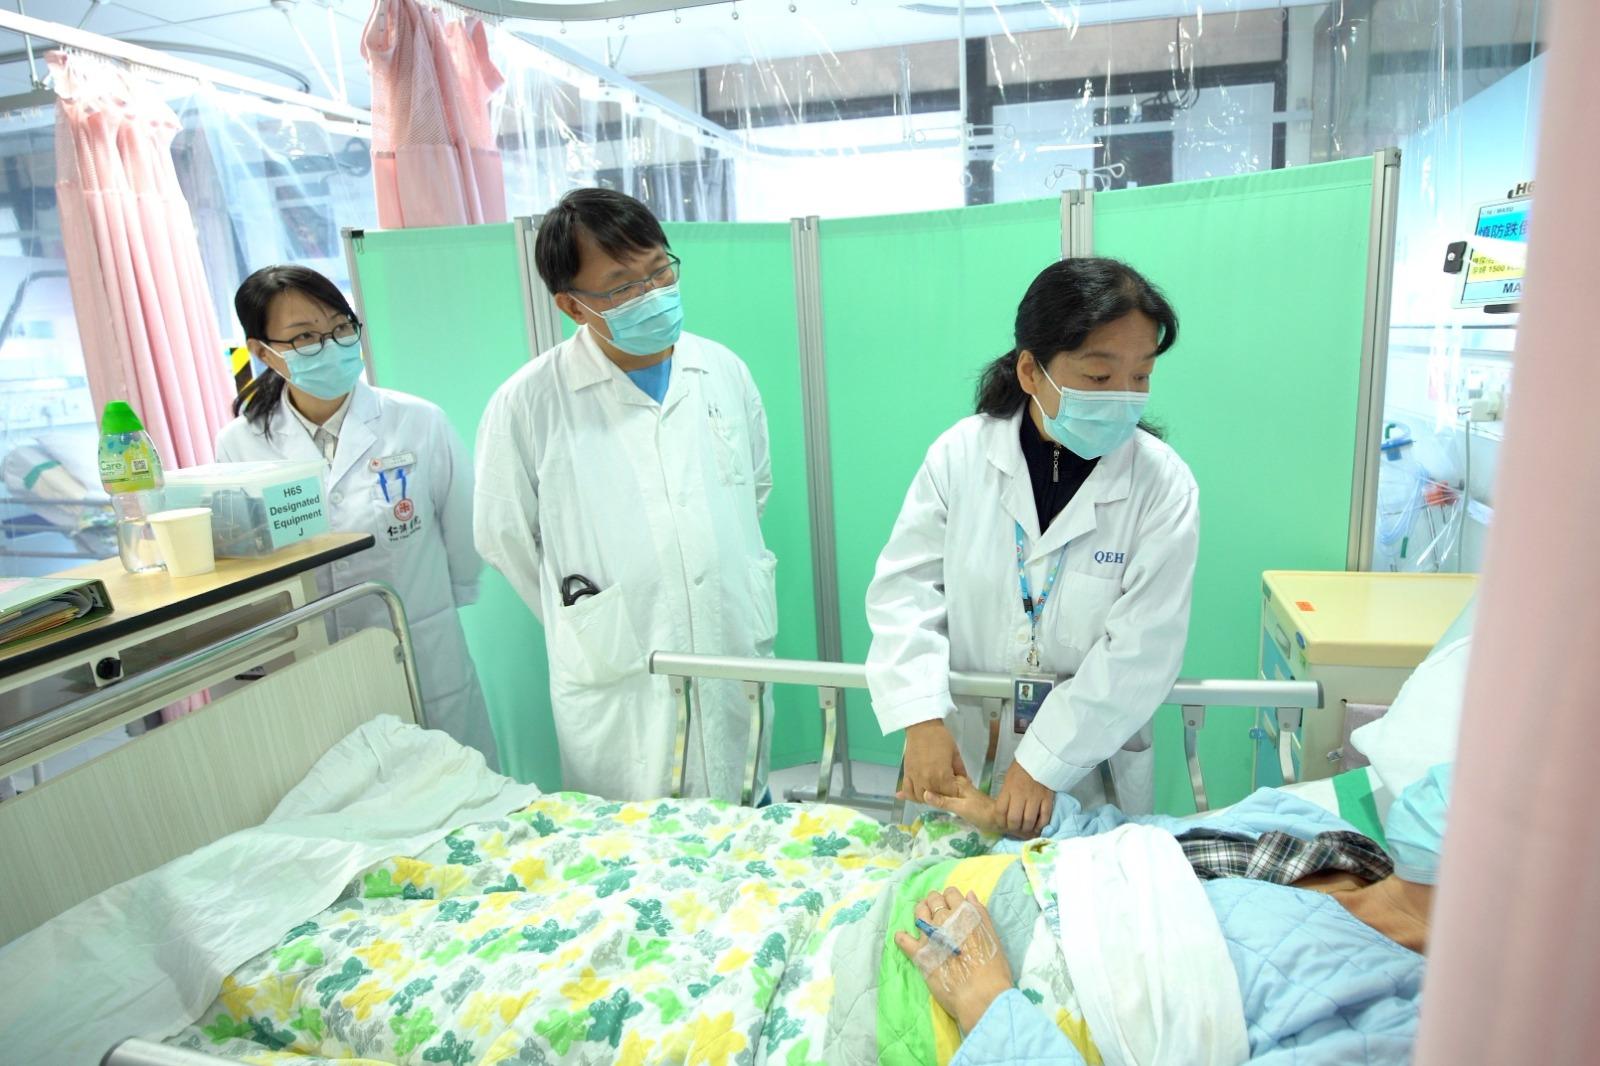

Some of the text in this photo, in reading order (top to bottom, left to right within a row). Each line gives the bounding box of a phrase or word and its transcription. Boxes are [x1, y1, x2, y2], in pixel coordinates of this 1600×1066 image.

[283, 485, 302, 498] H6S
[269, 494, 320, 516] Designated
[273, 508, 322, 530] Equipment
[298, 527, 304, 537] J
[1094, 550, 1126, 564] QEH
